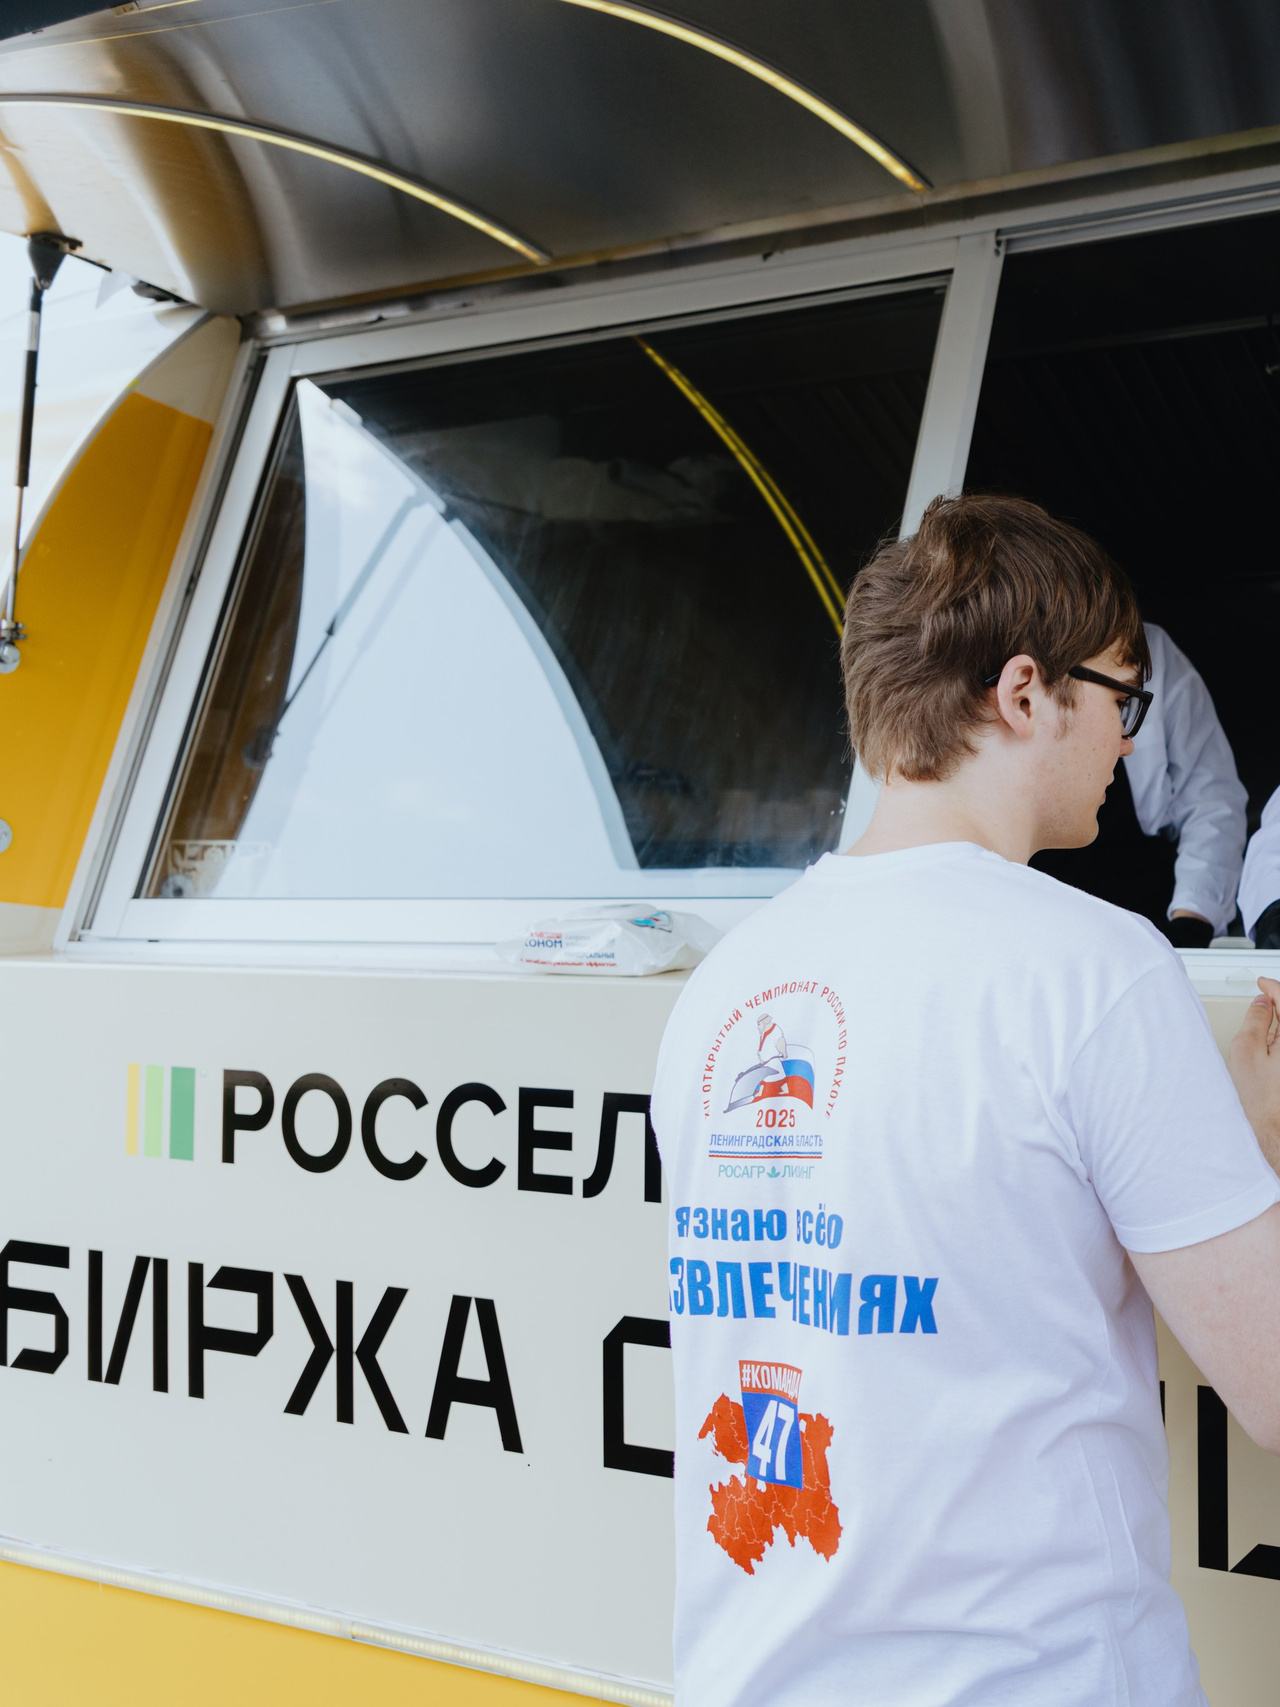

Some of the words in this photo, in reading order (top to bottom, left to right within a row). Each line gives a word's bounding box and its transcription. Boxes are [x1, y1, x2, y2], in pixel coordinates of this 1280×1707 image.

[525, 939, 562, 948] ОНОМ
[702, 1008, 743, 1093] ОТКРЫТЫЙ
[745, 981, 819, 1010] ЧЕМПИОНАТ
[820, 986, 846, 1028] РОССИИ
[837, 1029, 847, 1050] ПО
[709, 1134, 794, 1149] ЛЕНИНГРАДСКАЯ
[756, 1109, 796, 1128] 2025
[669, 1256, 939, 1336] ЗВЛЕЧЕНИЯХ
[0, 1239, 524, 1455] БИРЖА
[742, 1364, 801, 1400] #КОМАНДА
[752, 1399, 795, 1481] 47
